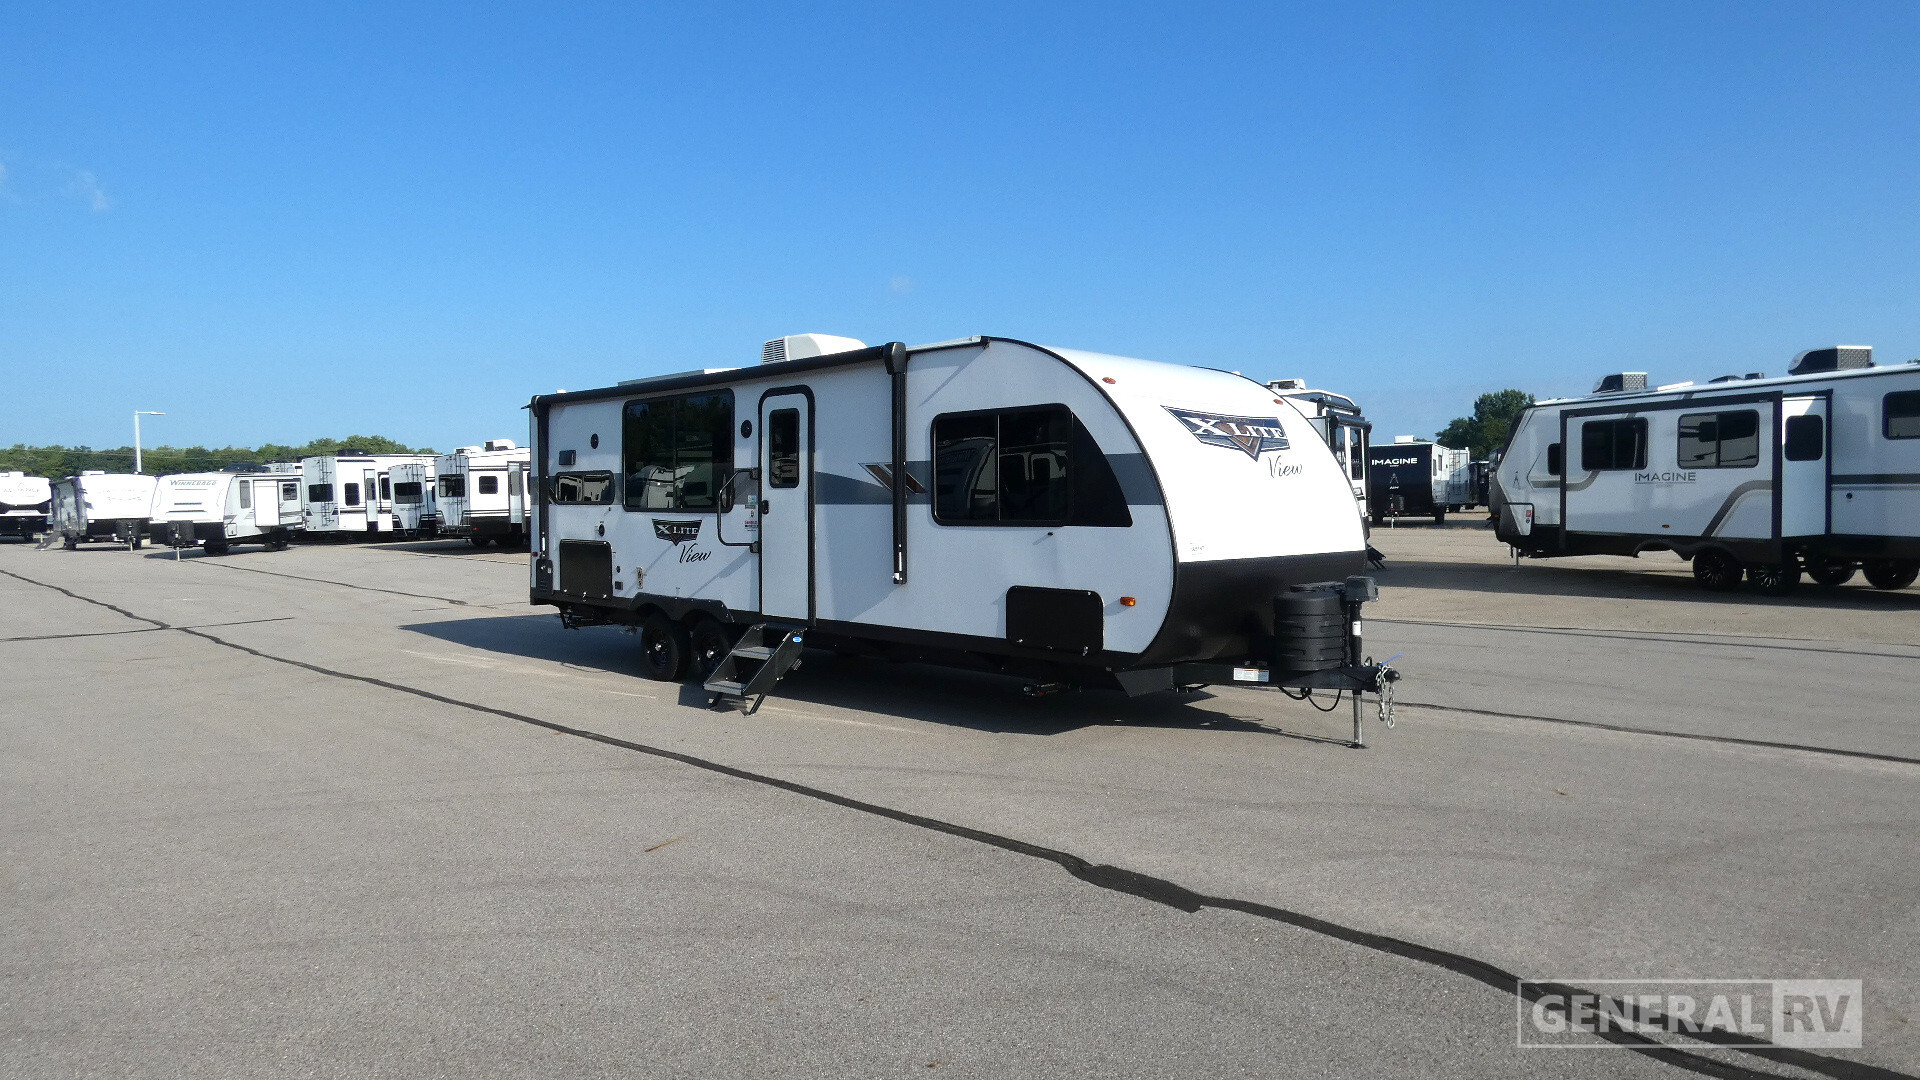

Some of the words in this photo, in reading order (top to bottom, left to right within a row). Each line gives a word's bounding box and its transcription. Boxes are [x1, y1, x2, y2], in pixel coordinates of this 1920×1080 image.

[1268, 455, 1302, 478] View
[1371, 457, 1418, 466] IMAGINE
[1634, 472, 1696, 482] IMAGINE
[679, 542, 712, 563] View
